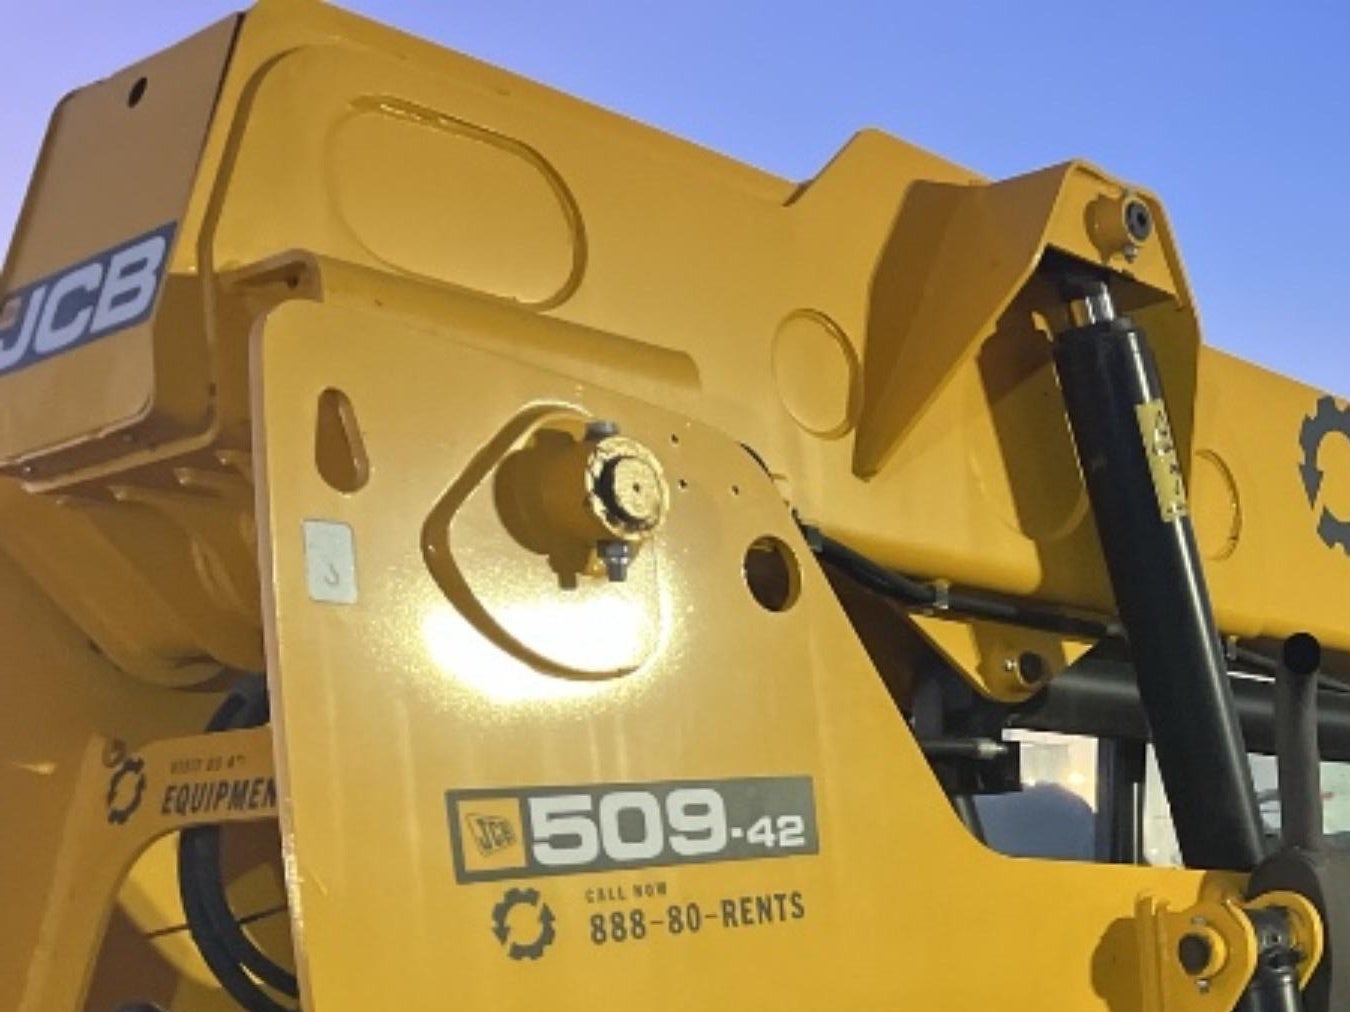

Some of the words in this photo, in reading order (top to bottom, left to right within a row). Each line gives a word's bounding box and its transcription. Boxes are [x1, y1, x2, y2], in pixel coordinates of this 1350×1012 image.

[0, 235, 166, 370] JCB
[584, 885, 628, 904] CALL
[632, 880, 668, 899] NOW
[590, 890, 806, 946] 888-80-RENTS
